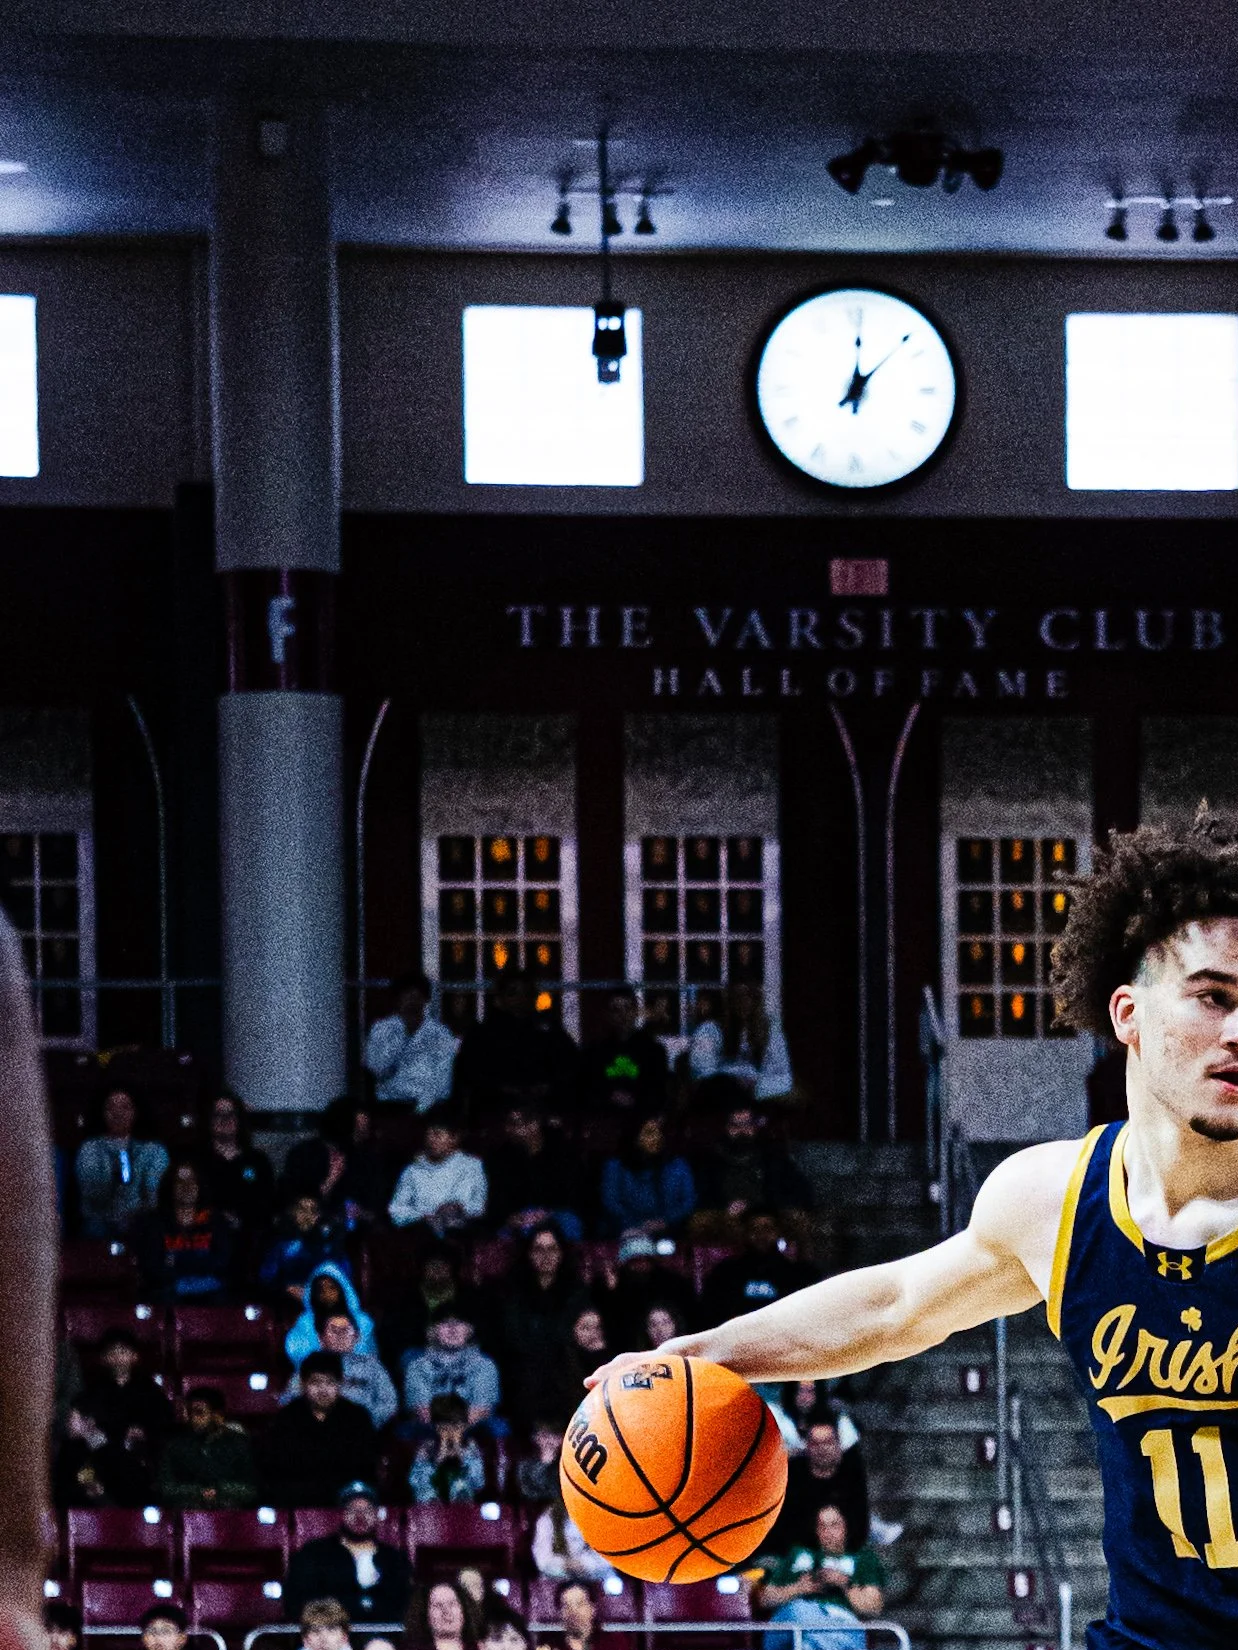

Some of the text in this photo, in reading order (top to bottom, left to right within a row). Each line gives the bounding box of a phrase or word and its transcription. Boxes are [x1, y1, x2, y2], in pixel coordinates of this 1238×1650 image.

[506, 605, 1227, 651] THE VARSITY CLUB
[651, 667, 1070, 698] HALL OF FAME
